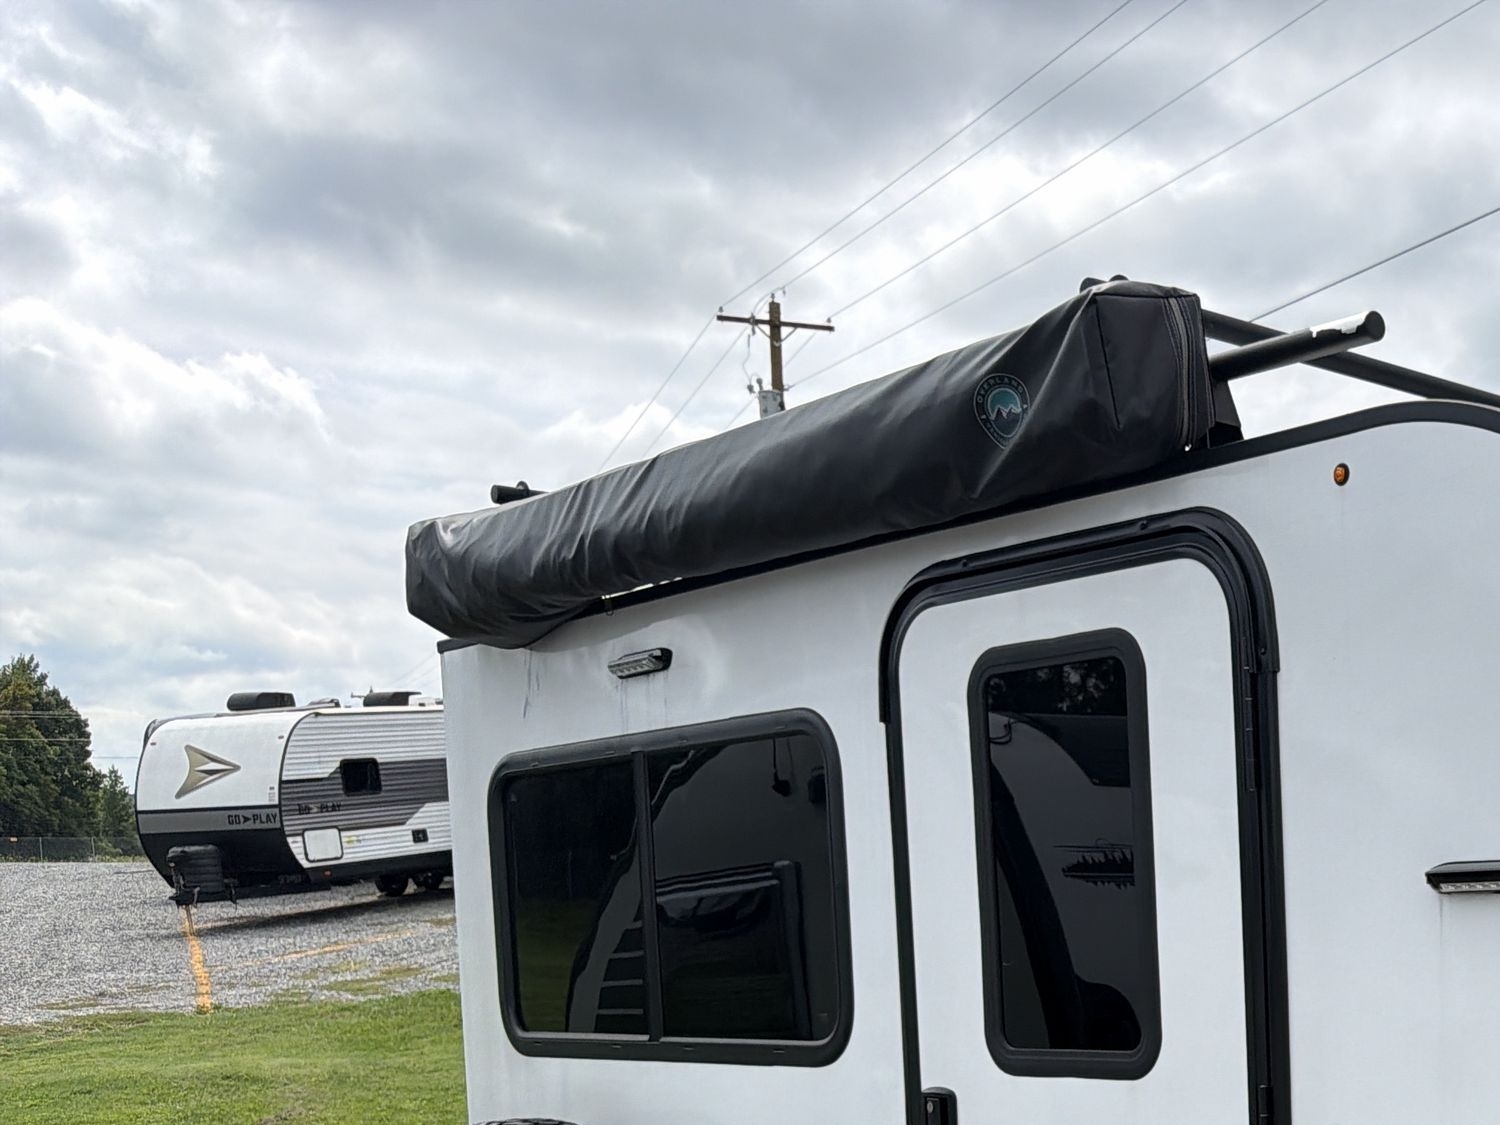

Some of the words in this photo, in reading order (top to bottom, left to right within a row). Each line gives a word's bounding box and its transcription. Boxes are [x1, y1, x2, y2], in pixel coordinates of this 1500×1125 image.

[977, 377, 1024, 403] OVERLAND
[227, 814, 241, 825] GO
[252, 813, 277, 825] PLAY
